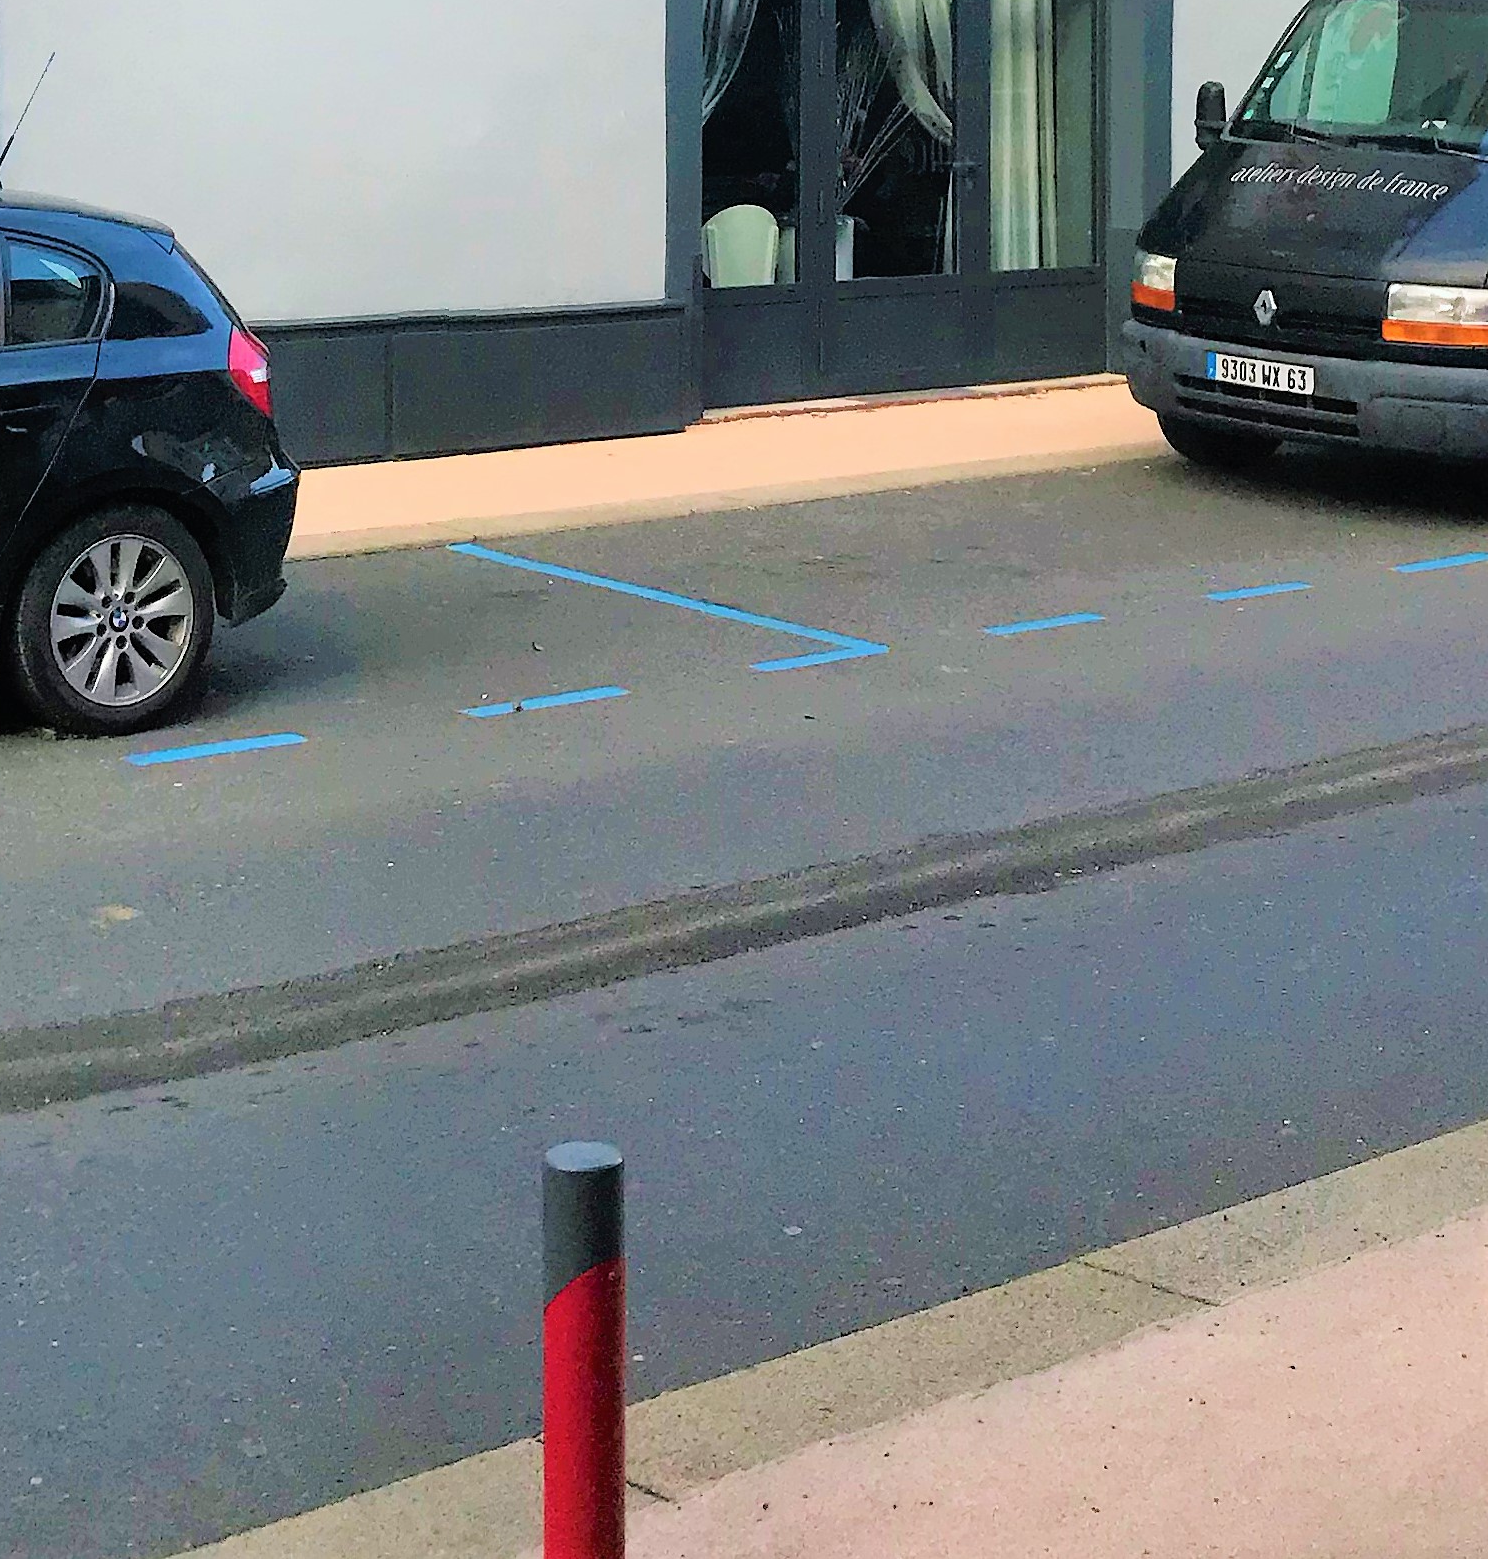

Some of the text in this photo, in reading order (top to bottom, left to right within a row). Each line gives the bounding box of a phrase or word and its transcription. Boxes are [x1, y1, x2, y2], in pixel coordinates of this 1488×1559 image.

[1230, 162, 1298, 183] ateliers
[1296, 165, 1358, 191] design
[1355, 169, 1385, 191] de
[1221, 358, 1307, 391] 9303 WX 63
